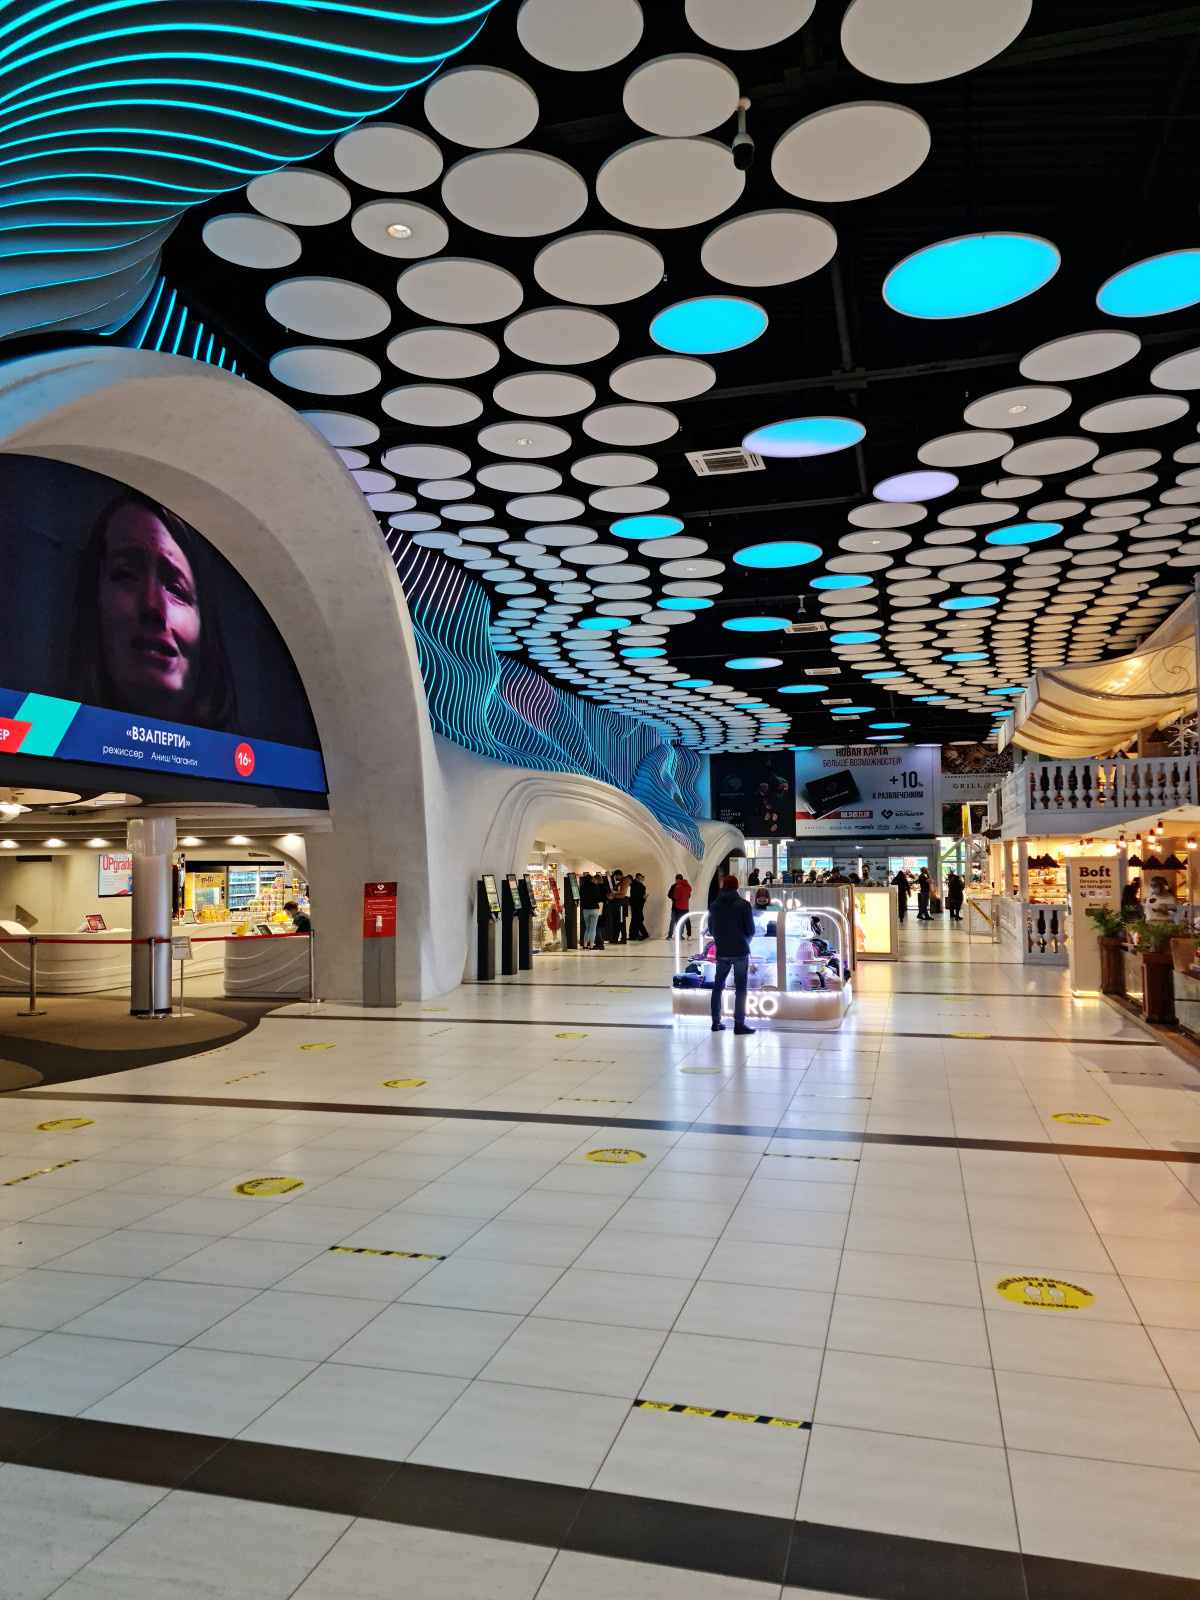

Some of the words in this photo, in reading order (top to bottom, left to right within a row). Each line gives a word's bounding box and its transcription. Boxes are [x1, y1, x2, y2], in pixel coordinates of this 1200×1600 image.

[126, 726, 191, 748] «ВЗАПЕРТИ»
[102, 745, 144, 759] режиссер
[150, 751, 171, 763] Аниш
[171, 754, 198, 766] Чаганти
[836, 748, 861, 757] НОВАЯ
[863, 747, 889, 756] КАРТА
[237, 752, 252, 766] 16+
[823, 758, 849, 768] БОЛЬШЕ
[850, 756, 903, 767] ВОЗМОЖНОСТЕЙ!
[872, 792, 877, 800] К
[878, 791, 924, 799] РАЗВЛЕЧЕНИЯМ
[1079, 866, 1111, 877] Boft
[723, 994, 778, 1016] LRO
